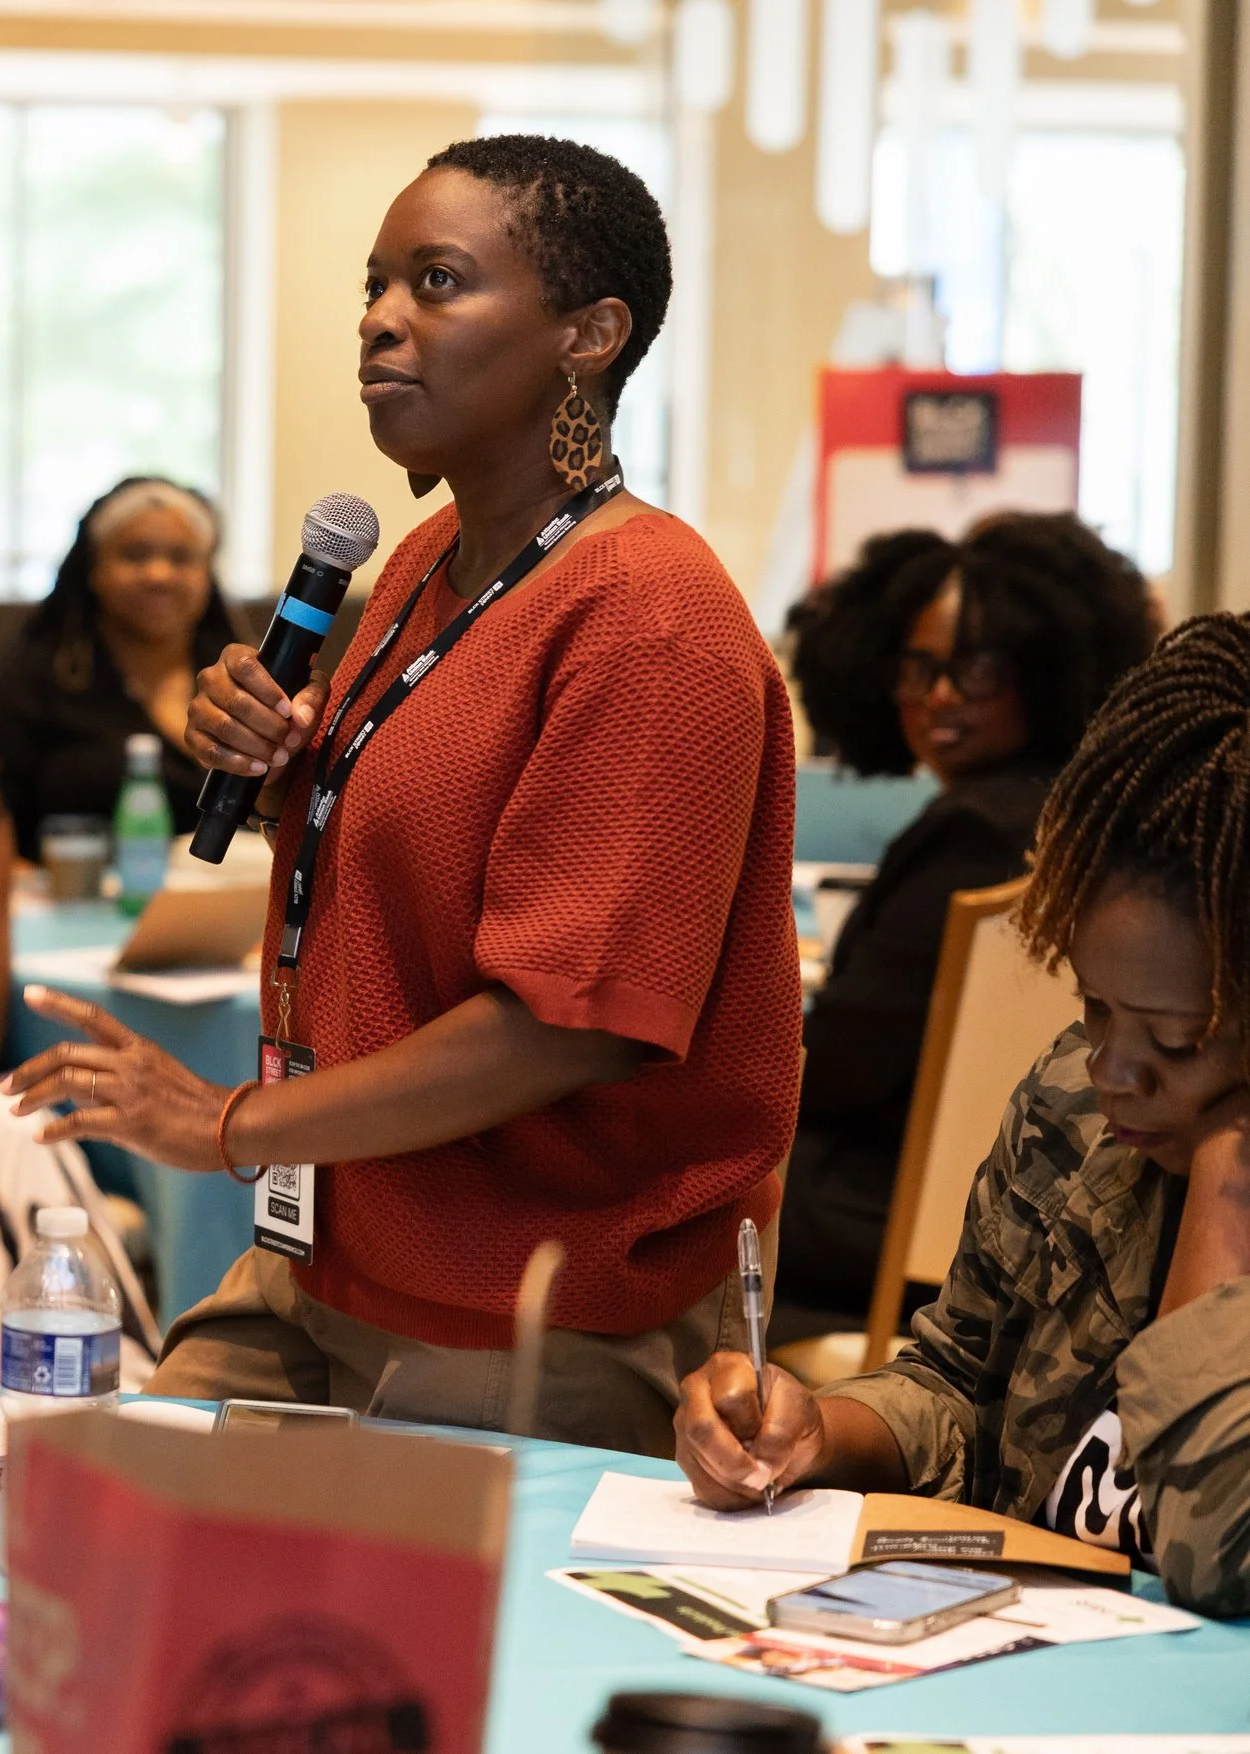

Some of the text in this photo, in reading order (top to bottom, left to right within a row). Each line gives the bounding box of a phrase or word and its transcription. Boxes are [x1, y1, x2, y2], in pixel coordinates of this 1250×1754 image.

[265, 1054, 281, 1069] BLCK
[270, 1201, 298, 1221] SCAN ME
